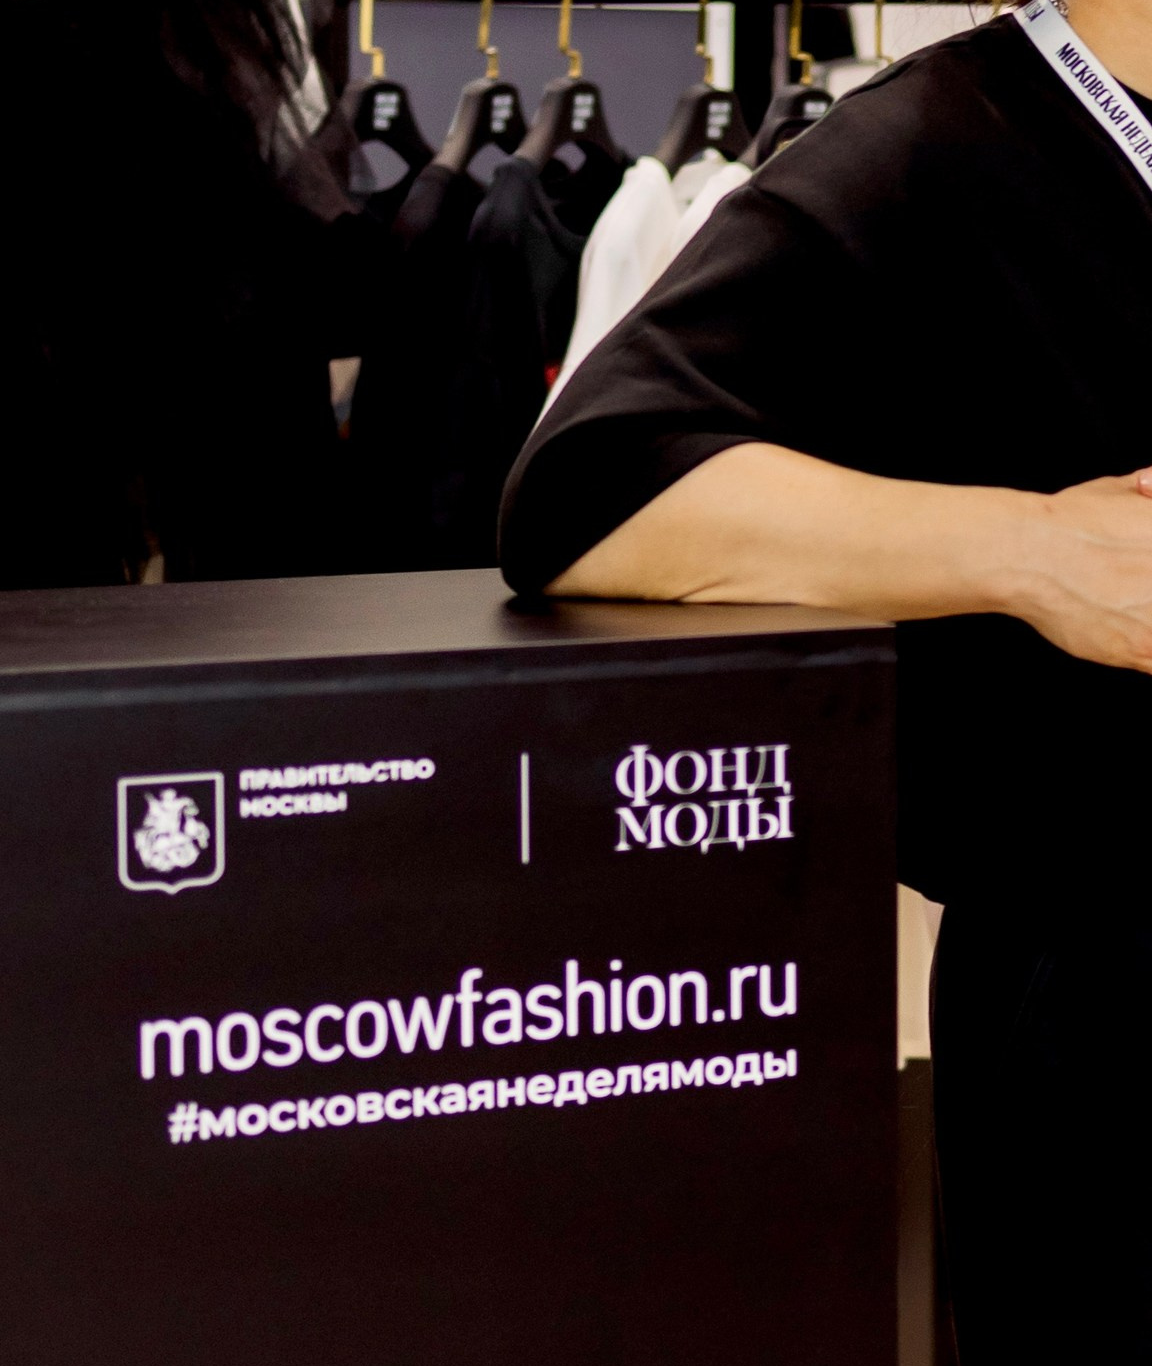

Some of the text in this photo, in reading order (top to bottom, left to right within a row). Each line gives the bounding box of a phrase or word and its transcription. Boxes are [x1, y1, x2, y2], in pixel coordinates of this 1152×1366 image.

[1056, 42, 1129, 125] МОСКОВСКАЯ
[239, 758, 436, 791] ПРАВИТЕЛЬСТВО
[240, 792, 348, 819] МОСКВЫ
[616, 744, 792, 807] ФОНД
[616, 795, 794, 854] МОДЫ
[141, 959, 797, 1080] moscowfashion.ru
[168, 1048, 797, 1144] #московскаянеделямоды
